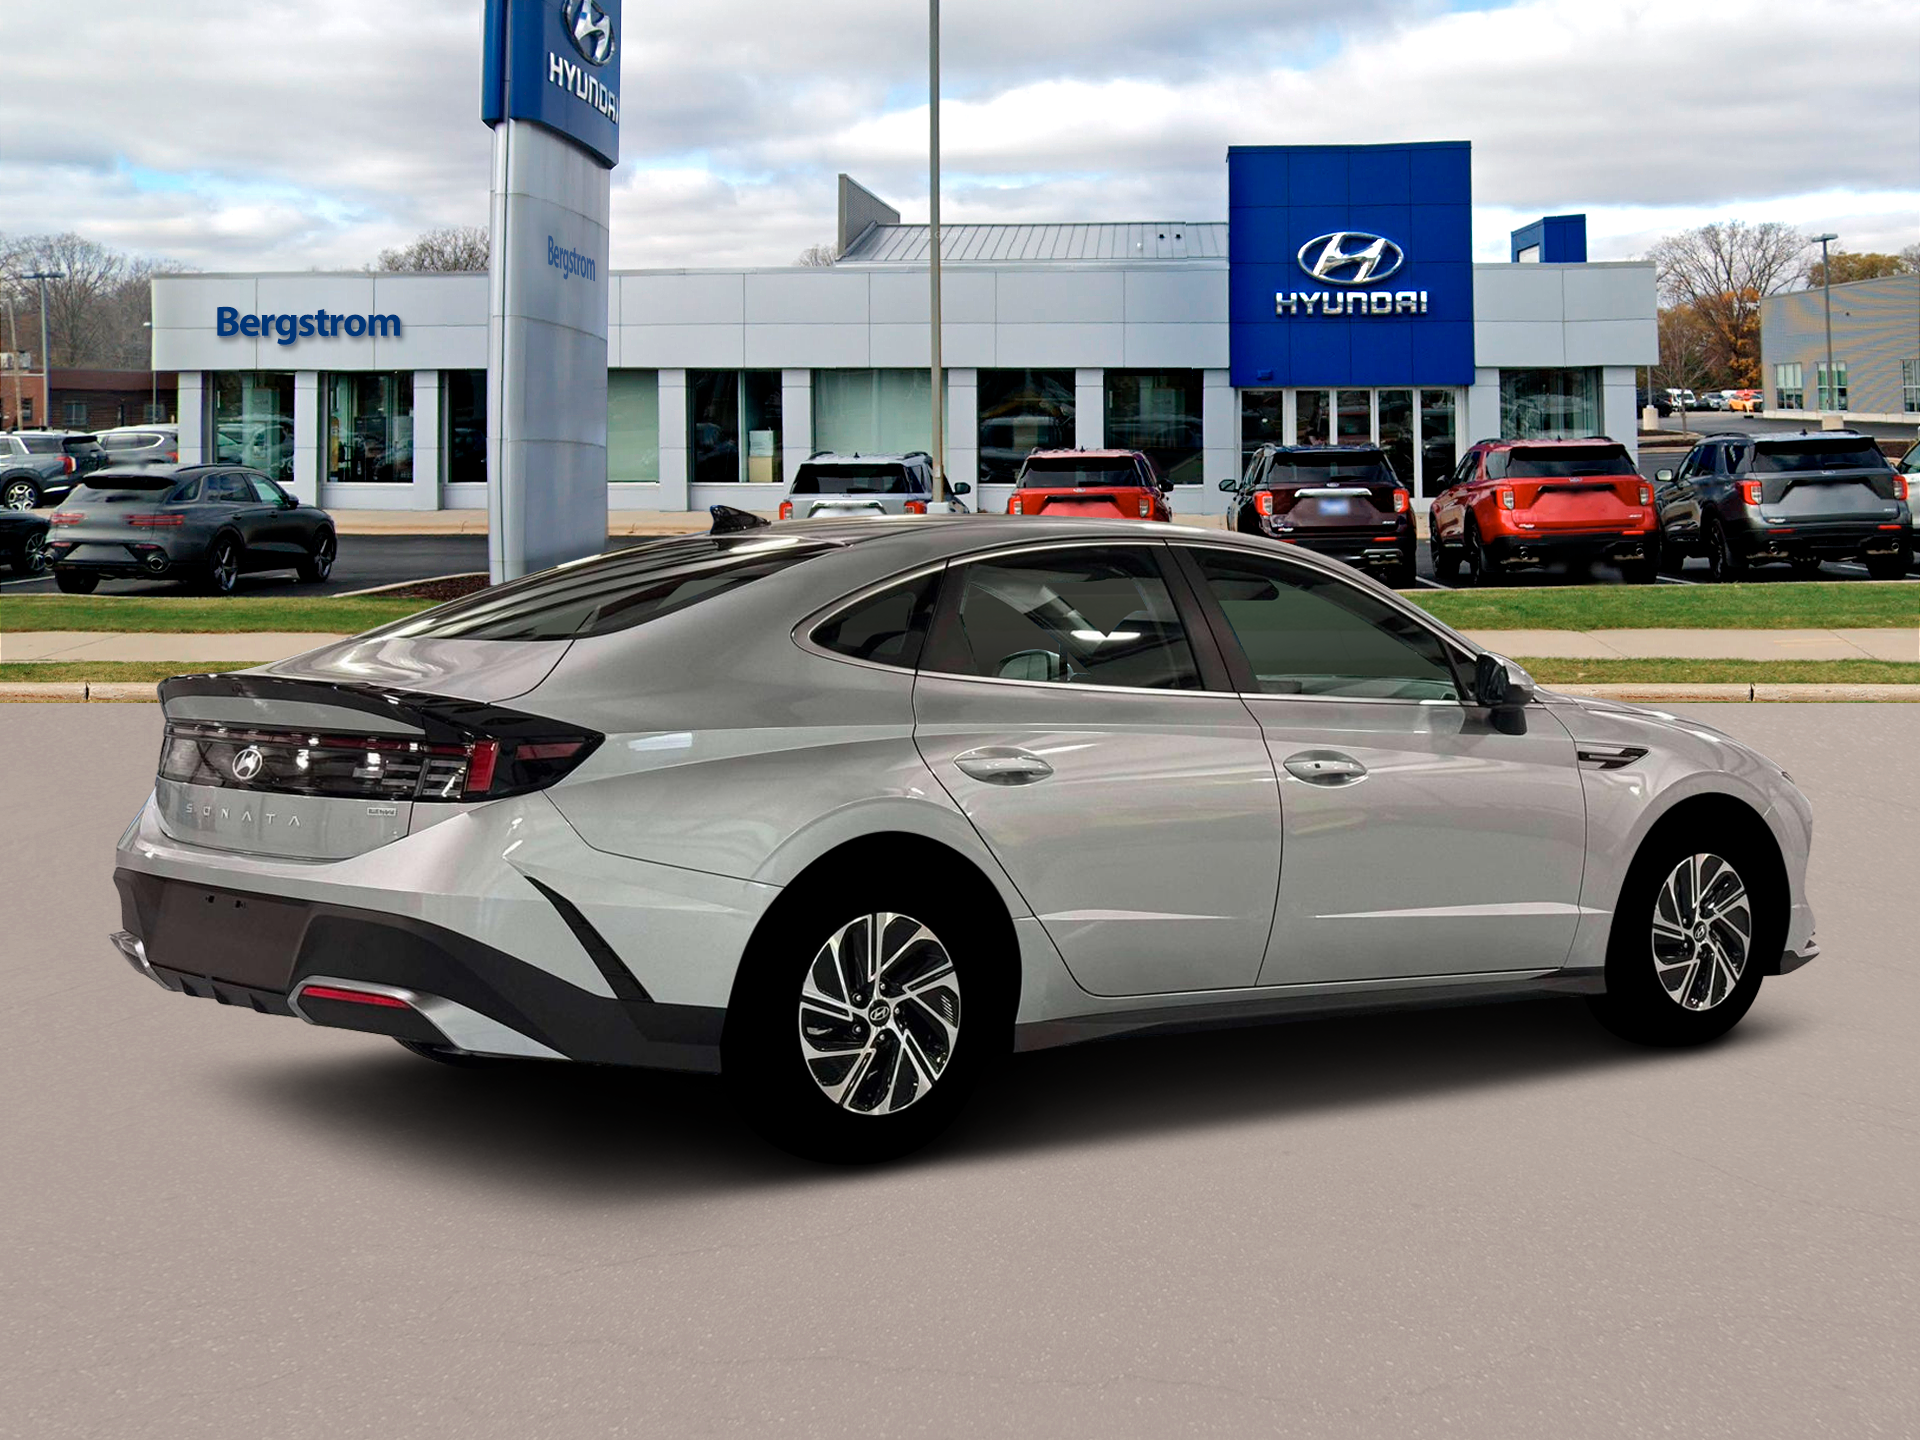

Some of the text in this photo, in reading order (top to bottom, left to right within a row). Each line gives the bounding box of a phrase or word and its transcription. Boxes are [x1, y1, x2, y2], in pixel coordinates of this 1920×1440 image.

[548, 52, 619, 124] HYUNDAI
[547, 235, 596, 281] Bergstrom
[1275, 291, 1428, 315] HYUNDAI
[216, 306, 402, 346] Bergstrom
[186, 803, 301, 827] SONATA
